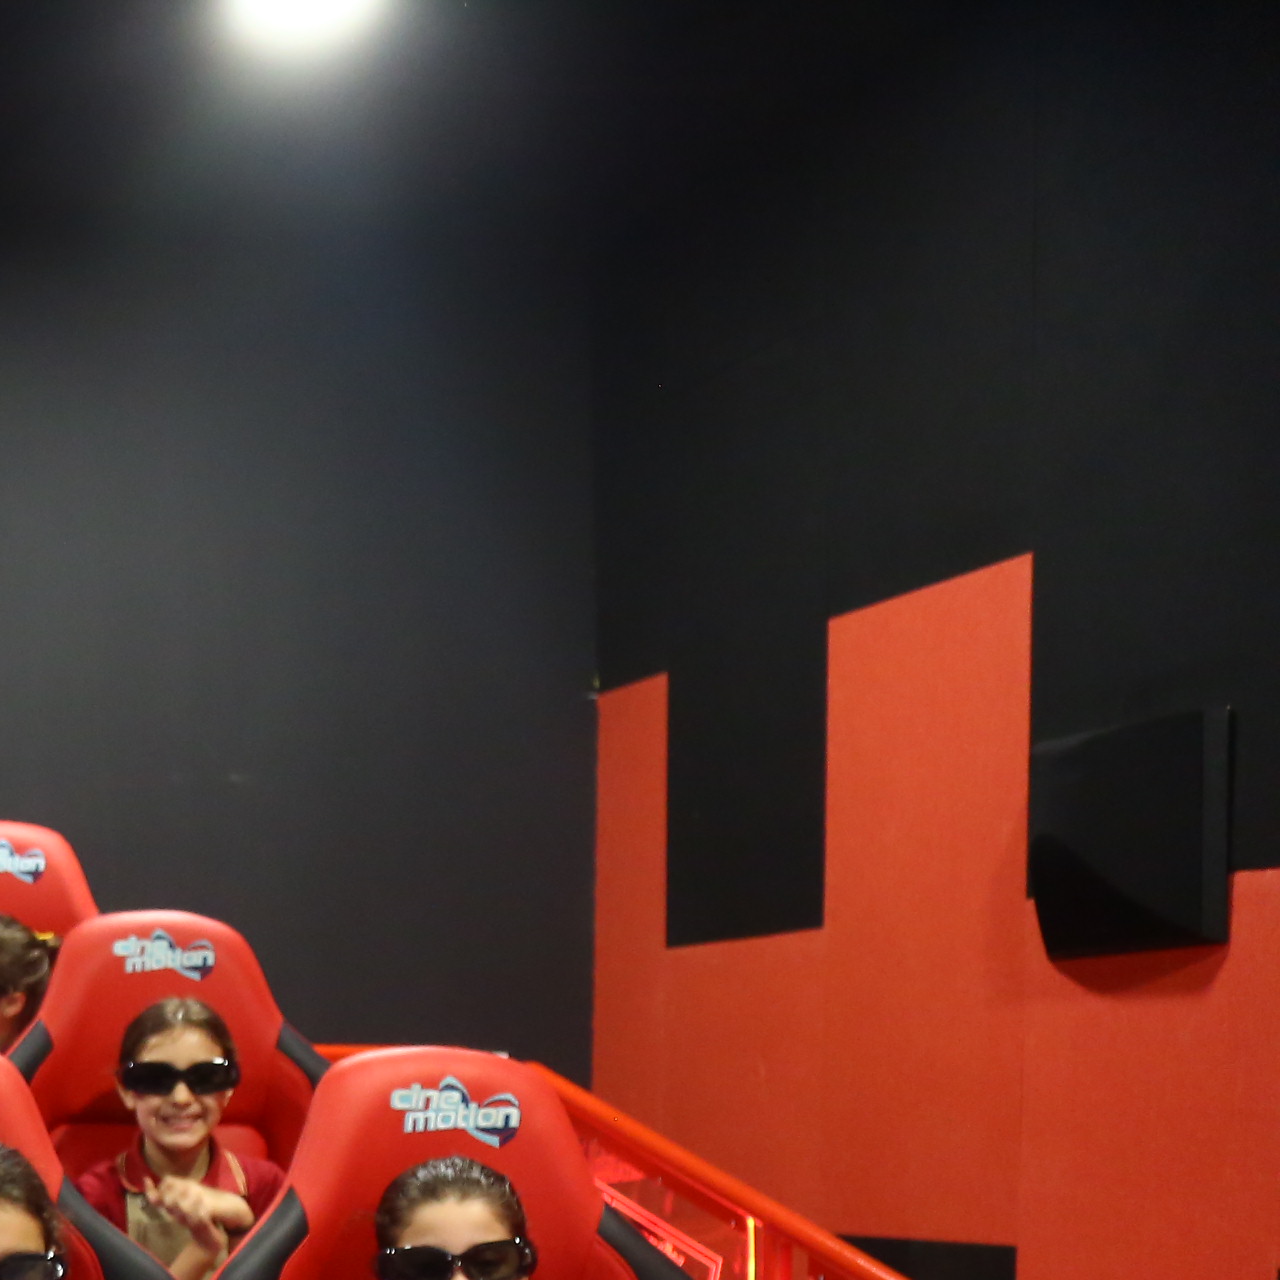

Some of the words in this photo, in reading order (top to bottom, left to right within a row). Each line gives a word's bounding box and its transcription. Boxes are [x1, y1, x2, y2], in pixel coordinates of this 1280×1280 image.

[113, 936, 170, 957] cine
[125, 947, 216, 973] motion
[390, 1082, 462, 1111] cine
[404, 1102, 521, 1133] motion
